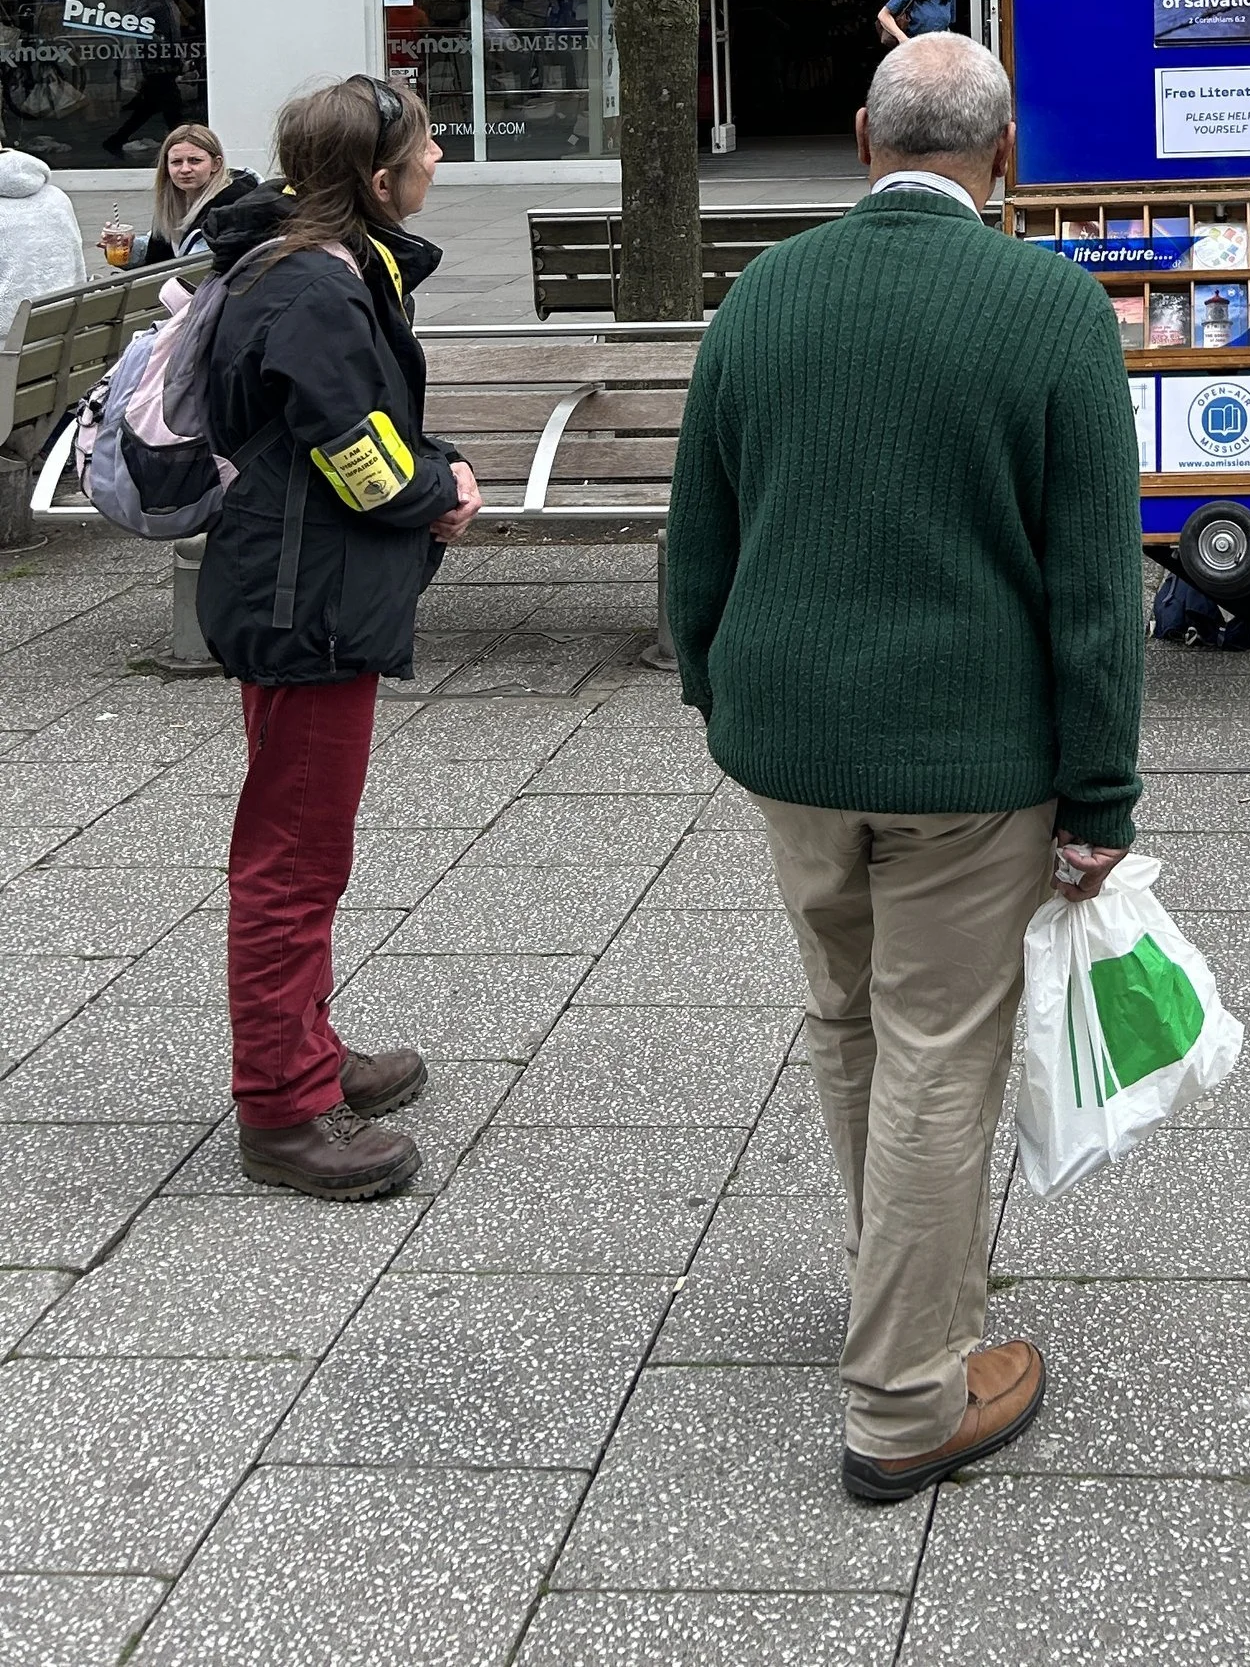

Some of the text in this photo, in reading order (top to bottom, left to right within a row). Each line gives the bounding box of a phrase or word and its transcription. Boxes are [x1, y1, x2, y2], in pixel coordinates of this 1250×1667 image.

[1234, 15, 1246, 23] 6:2
[79, 42, 207, 60] HOMESENS
[489, 34, 600, 53] HOMESEN
[1165, 88, 1196, 99] Free
[1185, 112, 1226, 122] PLEASE
[430, 122, 526, 135] OP TKMXX.COM
[1193, 124, 1249, 134] YOURSELF
[1072, 247, 1173, 263] literature....
[1197, 387, 1250, 407] OPEN-AIR
[348, 447, 361, 458] AM
[1200, 436, 1250, 453] MISSION
[339, 448, 373, 471] VISUALLY
[345, 456, 378, 478] IMPAIRED
